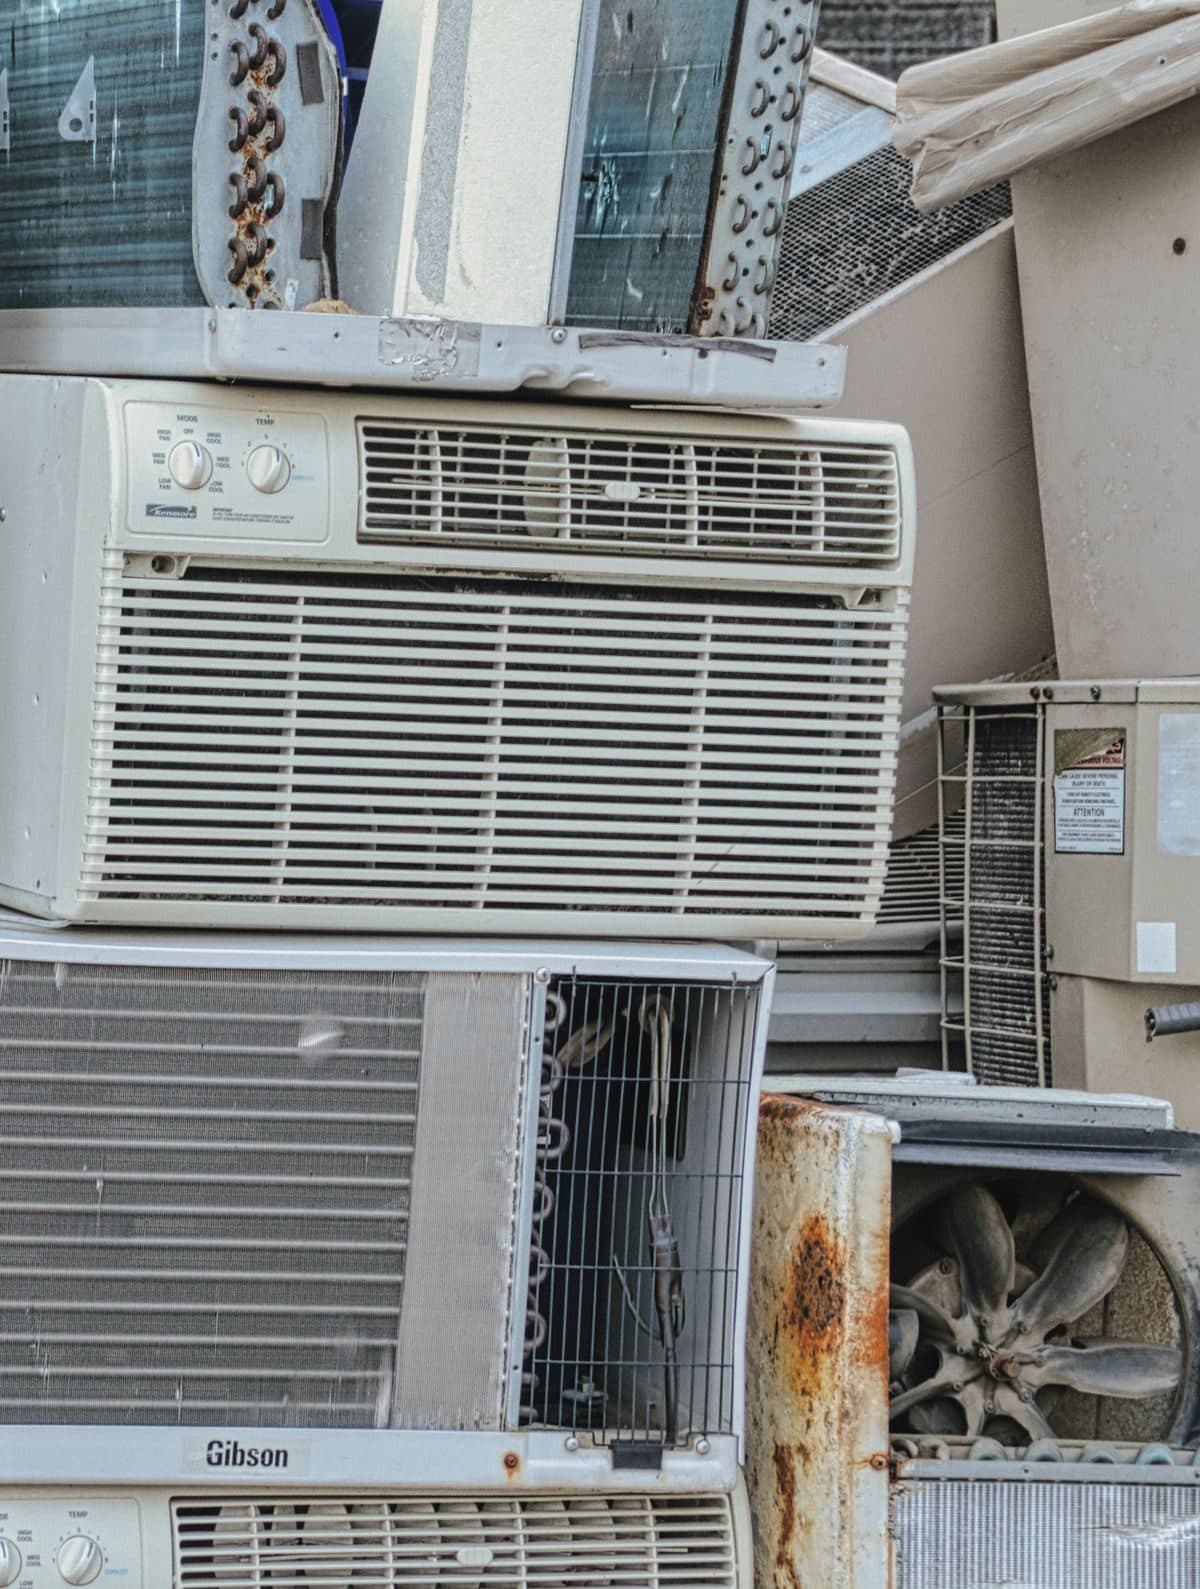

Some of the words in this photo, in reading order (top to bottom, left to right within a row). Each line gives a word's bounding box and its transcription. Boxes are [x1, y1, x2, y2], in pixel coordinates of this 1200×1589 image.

[176, 415, 198, 423] MODE
[255, 418, 275, 426] TEMP
[154, 507, 197, 519] Kenmore
[1073, 808, 1105, 817] ATTENTION
[206, 1440, 289, 1467] Gibson
[68, 1511, 88, 1519] TEMP
